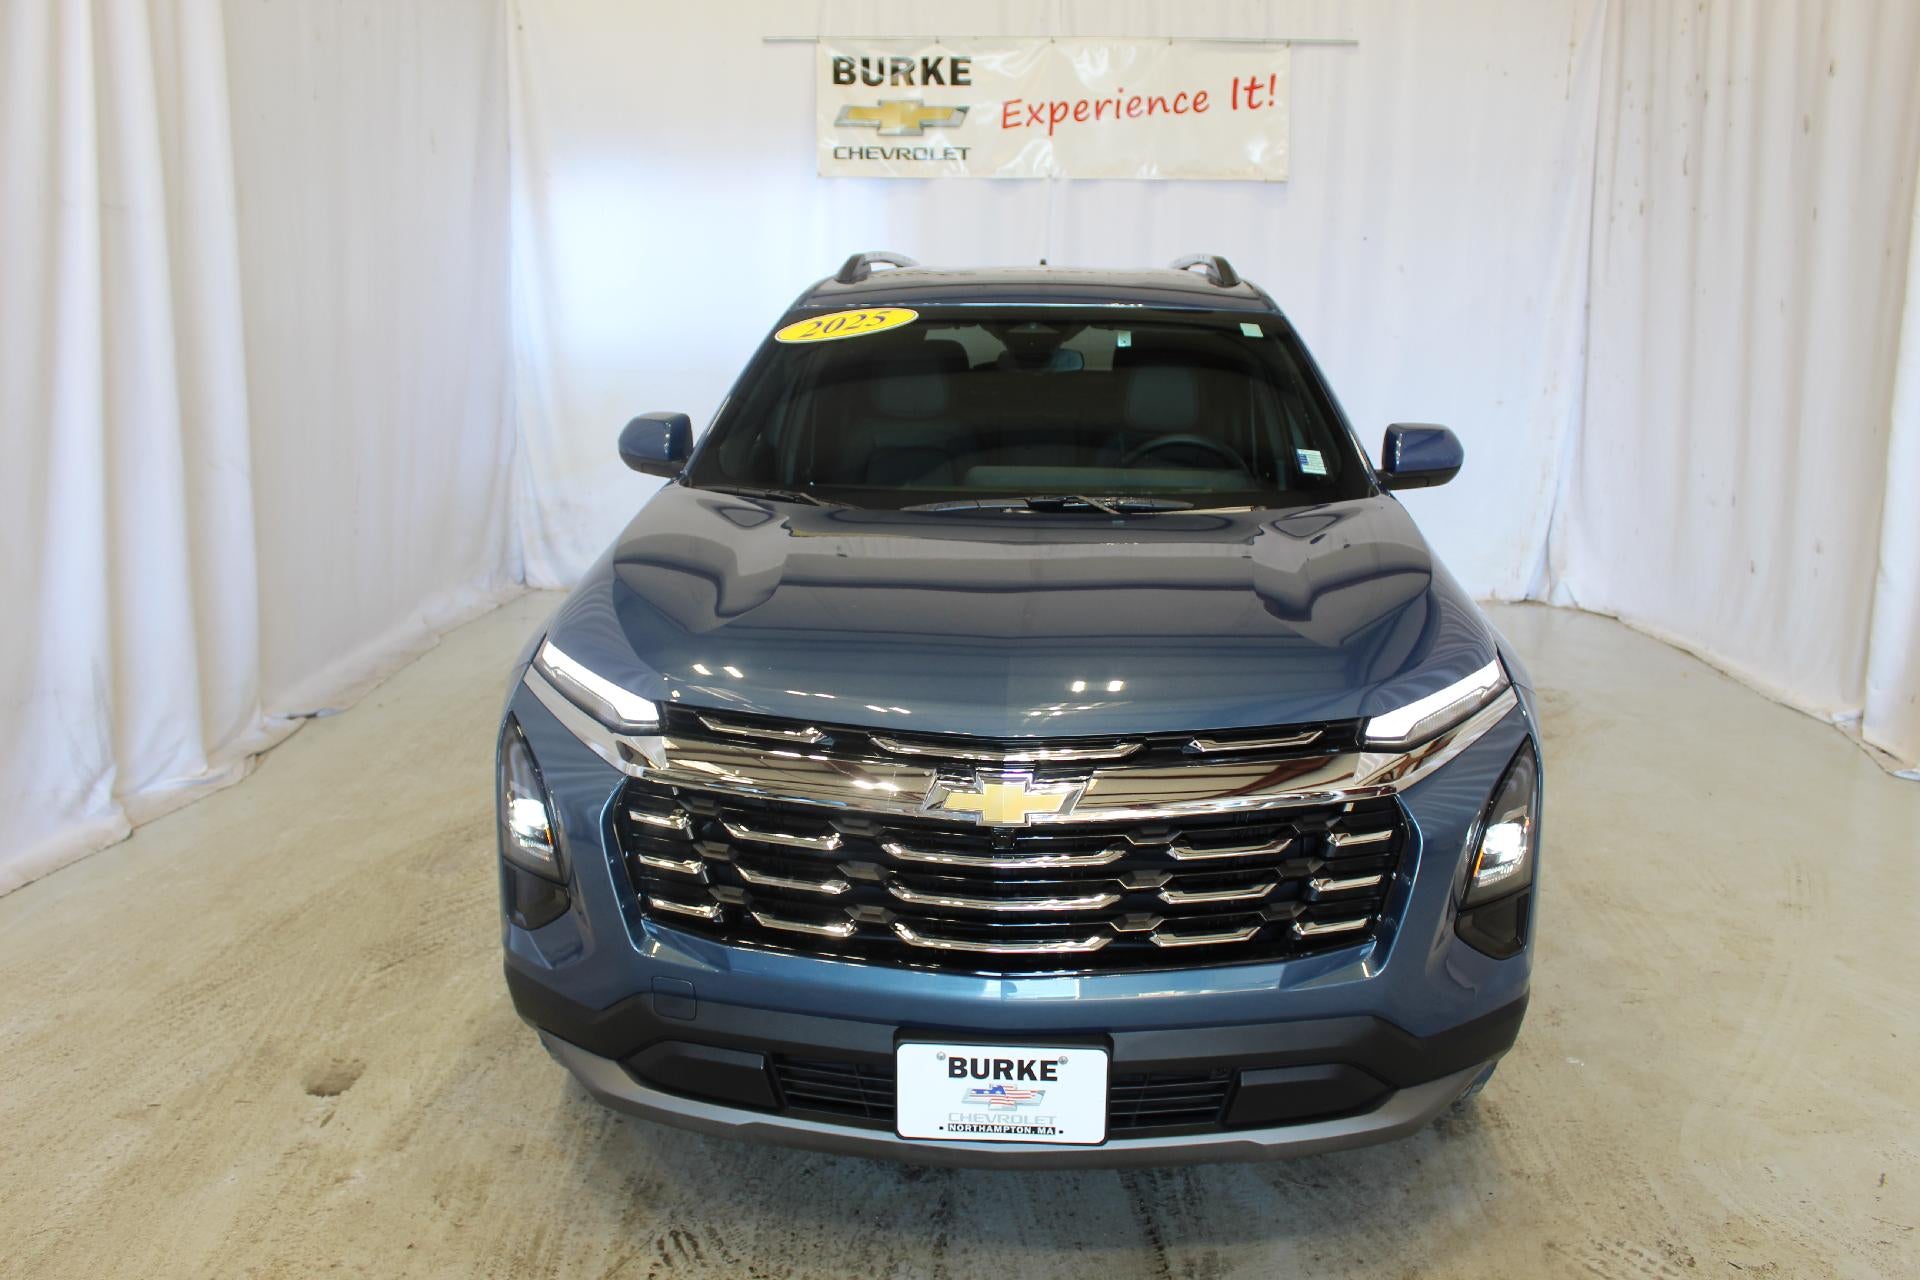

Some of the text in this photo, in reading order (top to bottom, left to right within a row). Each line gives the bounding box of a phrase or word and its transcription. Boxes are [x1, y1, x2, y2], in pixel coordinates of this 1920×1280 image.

[833, 56, 972, 86] BURKE
[1001, 73, 1277, 136] Experience It!
[833, 146, 971, 161] CHEVROLET
[800, 311, 891, 338] 2025
[948, 1057, 1058, 1081] BURKE
[948, 1113, 1056, 1125] CHEVROLET
